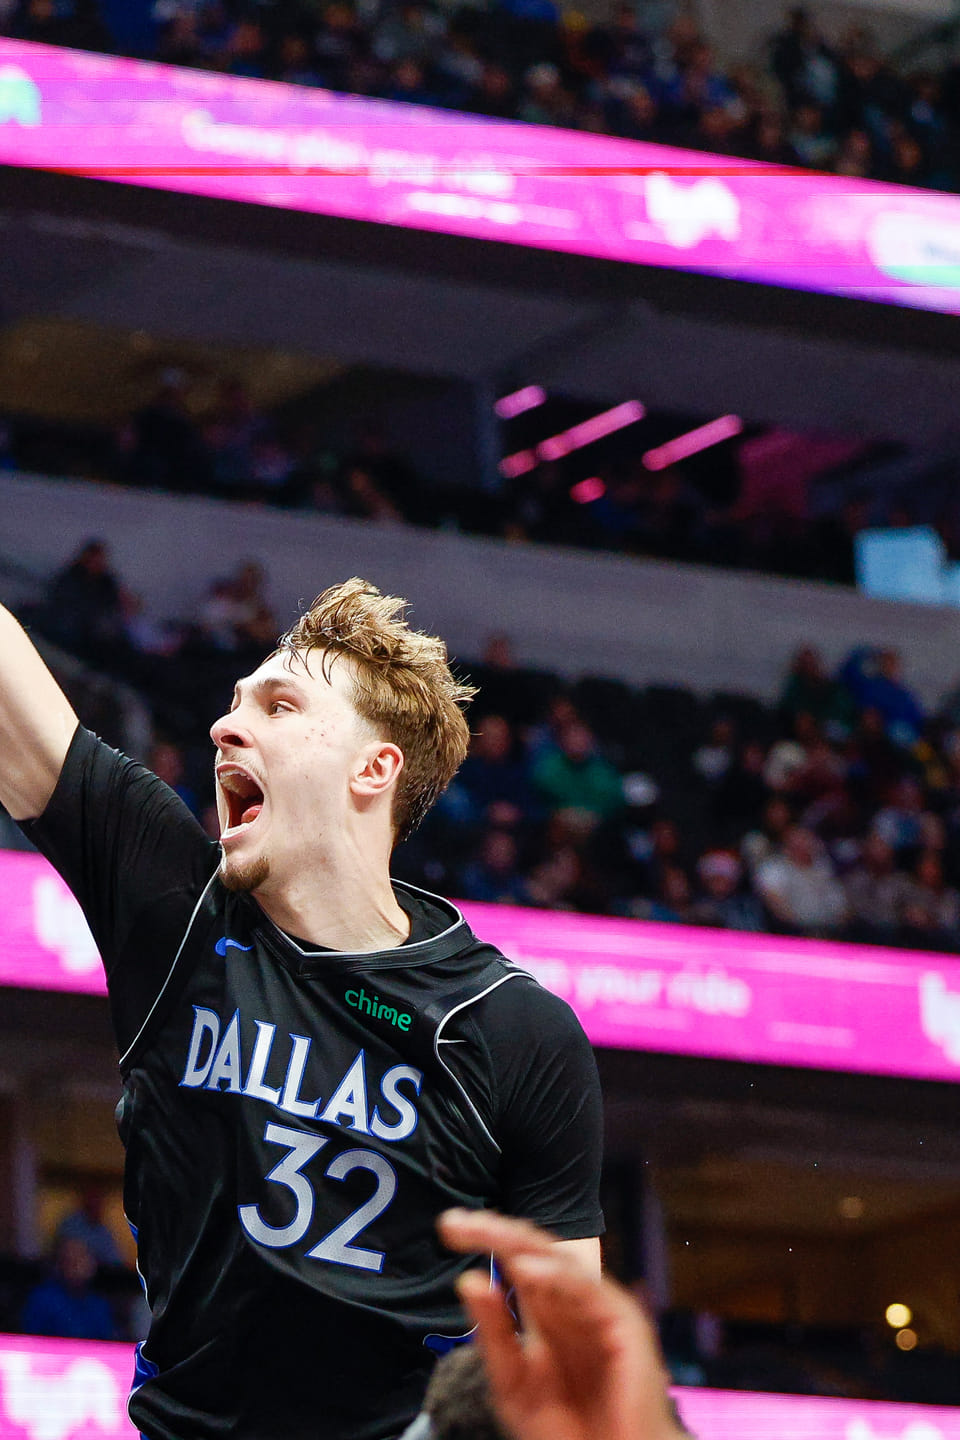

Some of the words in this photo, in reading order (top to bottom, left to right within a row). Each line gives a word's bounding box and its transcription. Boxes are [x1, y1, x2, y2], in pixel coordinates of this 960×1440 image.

[178, 1004, 425, 1142] DALLAS
[344, 988, 413, 1032] chime
[237, 1121, 398, 1274] 32
